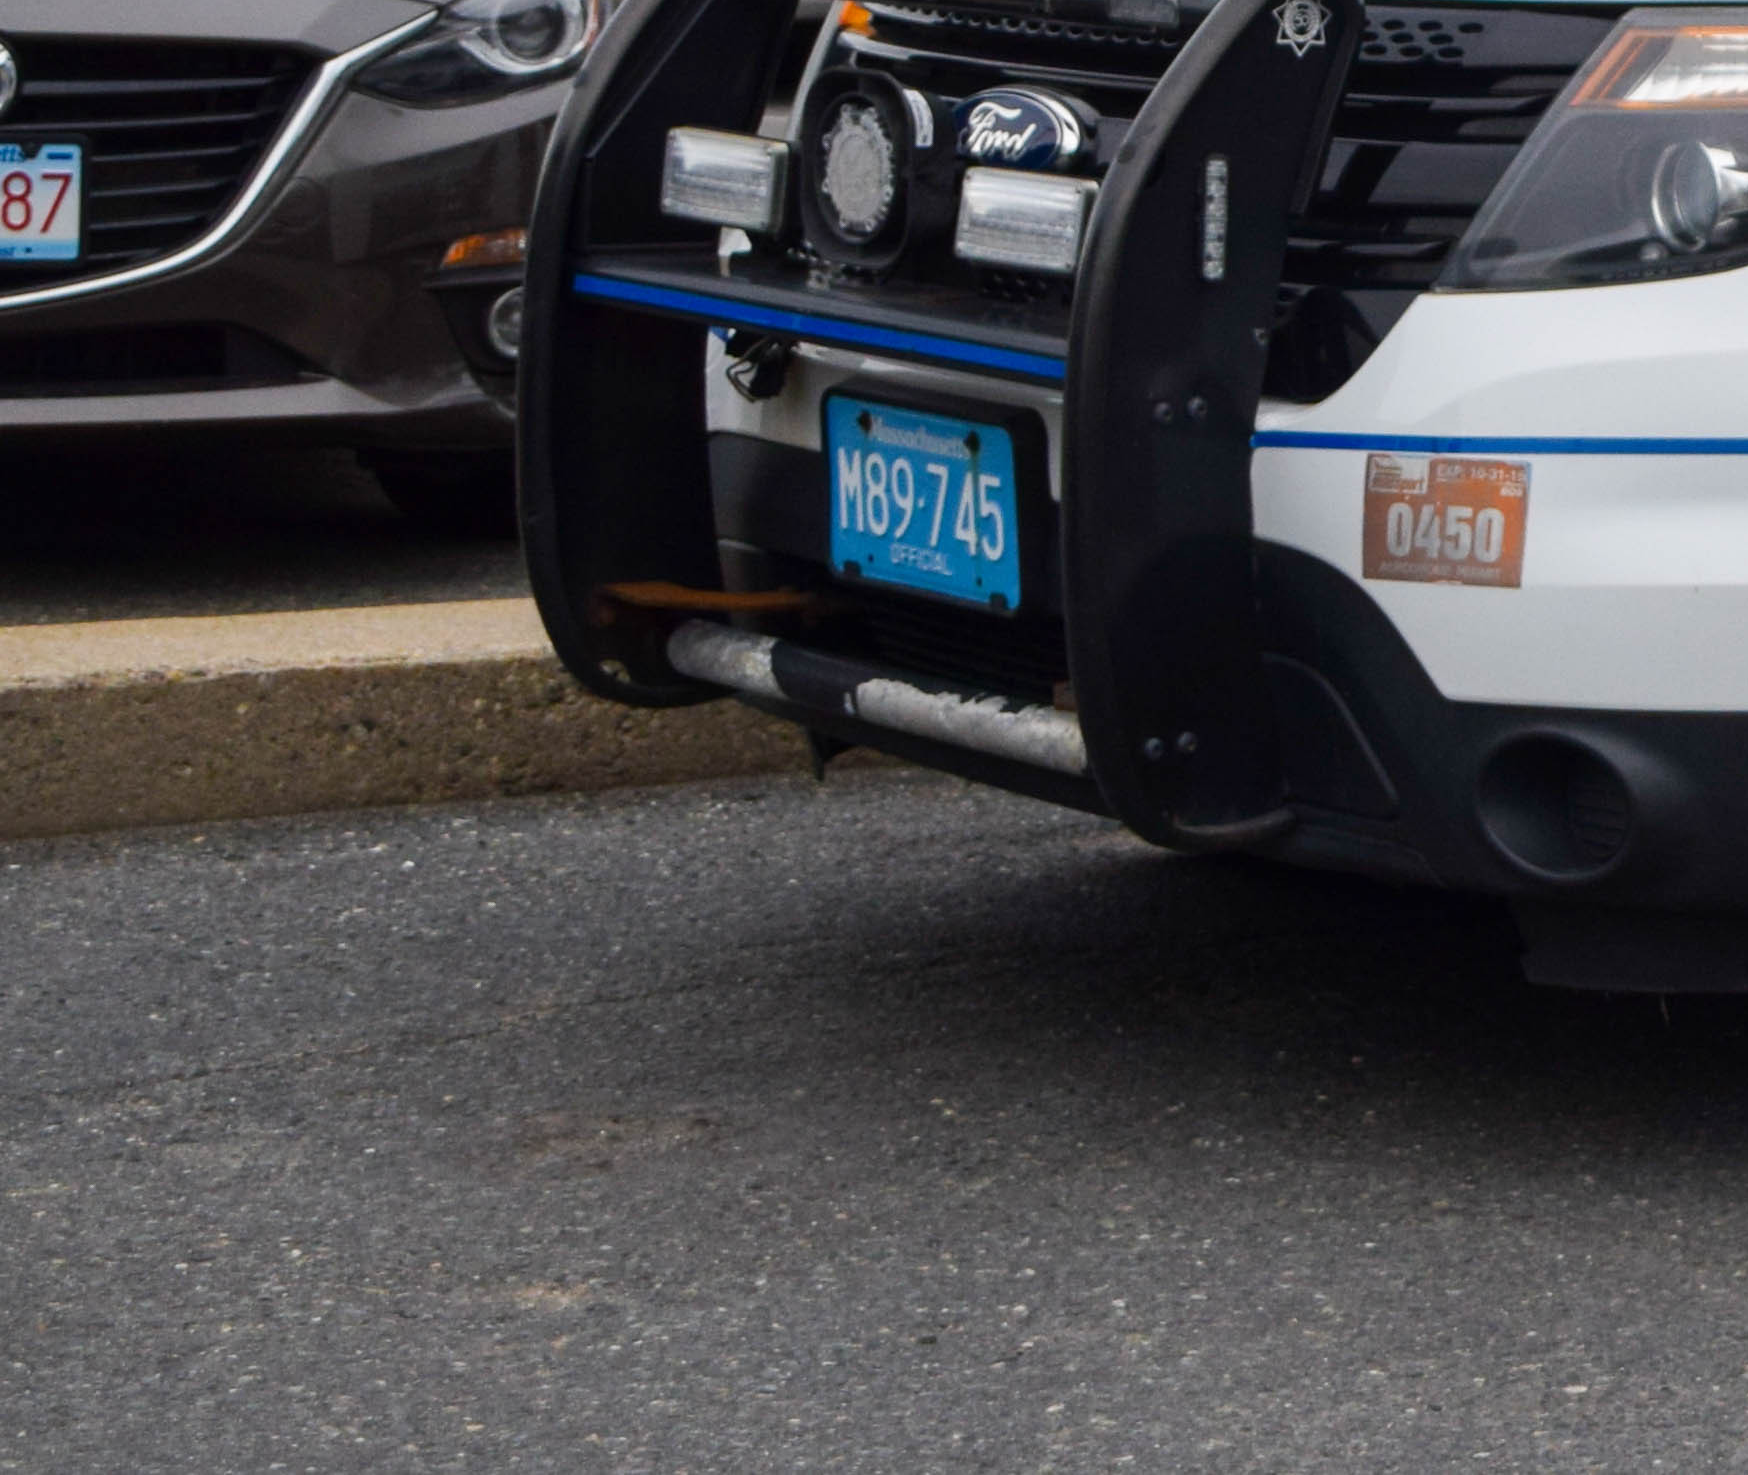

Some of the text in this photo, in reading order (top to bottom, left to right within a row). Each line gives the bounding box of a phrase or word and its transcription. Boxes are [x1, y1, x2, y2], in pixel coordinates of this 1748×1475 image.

[958, 101, 1037, 161] Ford
[0, 170, 73, 234] 87
[1386, 501, 1505, 564] 0450
